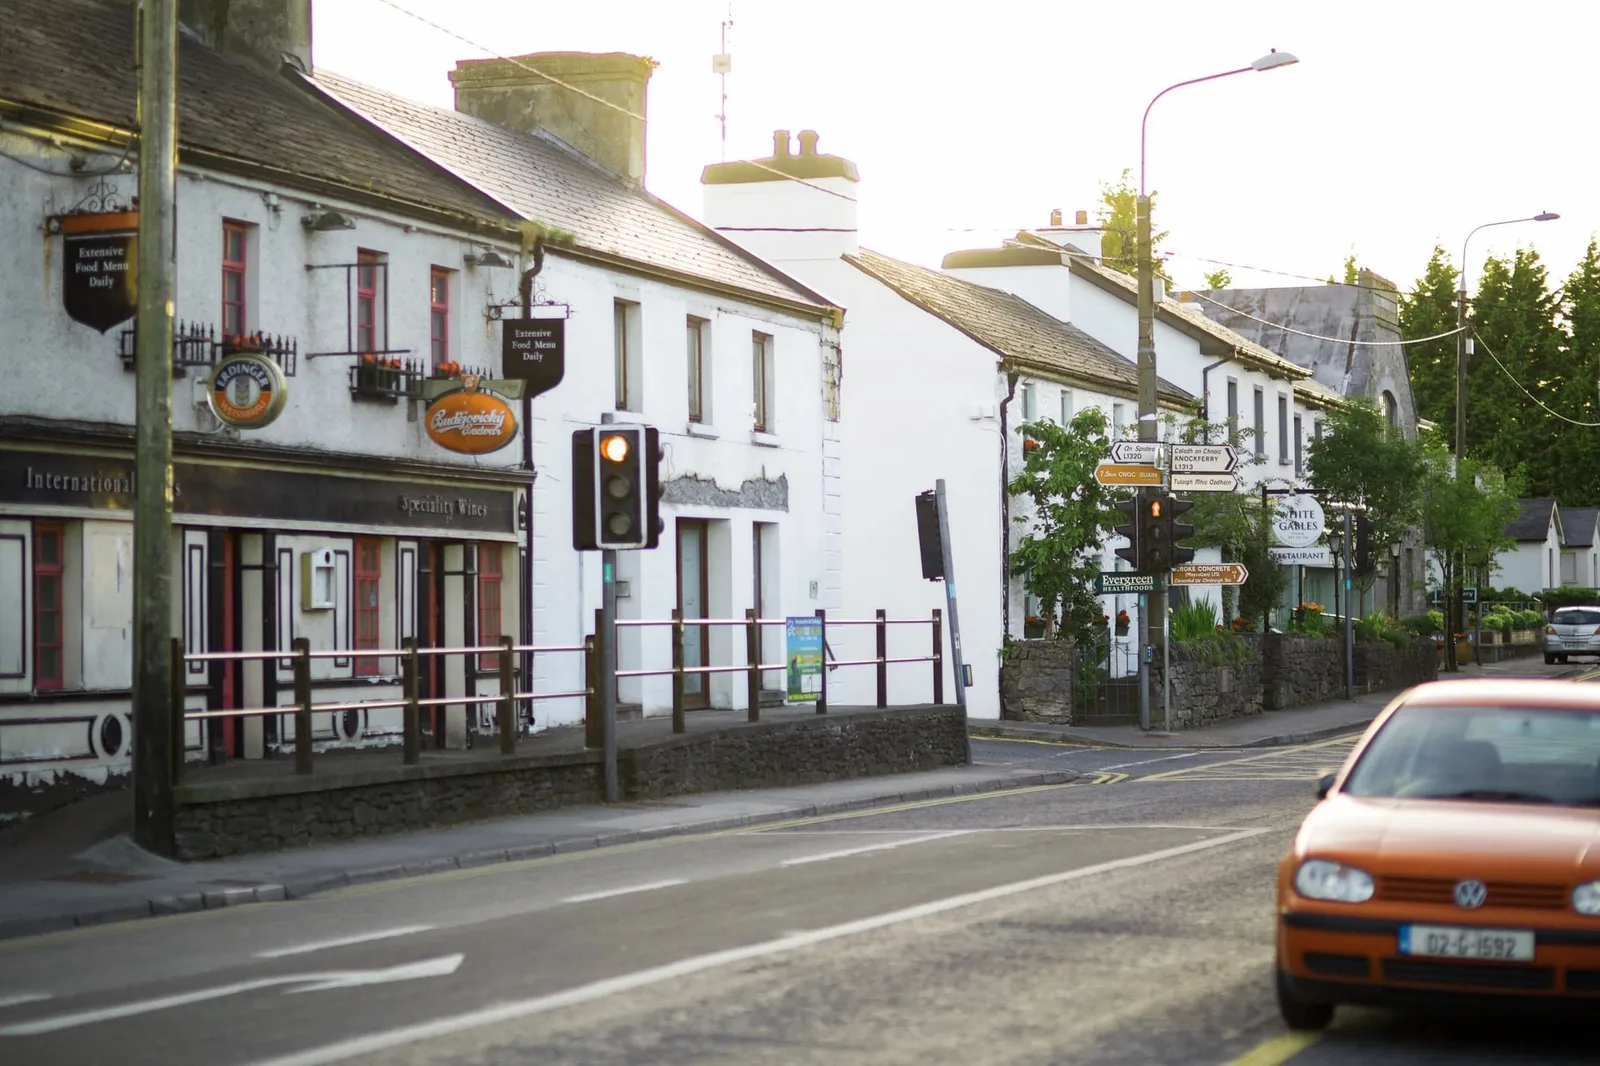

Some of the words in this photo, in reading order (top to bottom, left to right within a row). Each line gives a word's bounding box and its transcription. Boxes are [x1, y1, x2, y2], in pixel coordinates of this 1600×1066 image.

[79, 247, 124, 258] Extensive
[75, 261, 98, 273] Food
[103, 261, 129, 271] Menu
[89, 276, 114, 288] Daily
[515, 329, 551, 337] Extensive
[512, 341, 530, 349] Food
[534, 341, 556, 349] Menu
[523, 352, 543, 362] Daily
[217, 364, 269, 387] ERDINGER
[27, 467, 135, 494] International
[402, 496, 454, 517] Speciality
[458, 498, 488, 517] Wines
[1283, 510, 1315, 518] HITE
[1279, 522, 1318, 530] GABLES
[1102, 575, 1153, 586] Evergreen
